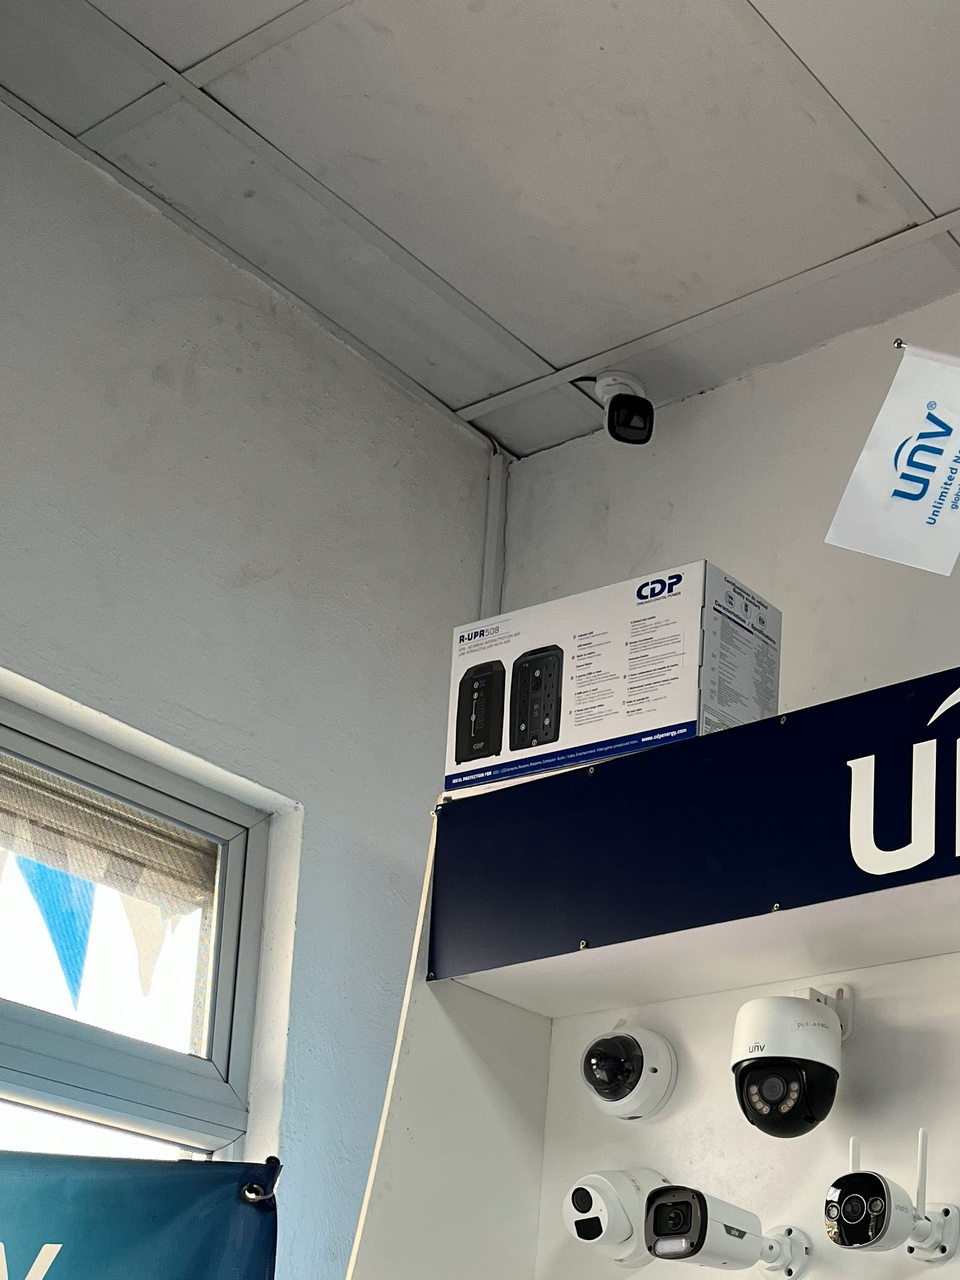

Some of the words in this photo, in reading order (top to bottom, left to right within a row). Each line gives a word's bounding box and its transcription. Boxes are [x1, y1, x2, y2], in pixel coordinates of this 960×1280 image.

[925, 465, 959, 527] Unlimited
[636, 574, 682, 600] CDP
[459, 626, 500, 644] R-UPR508
